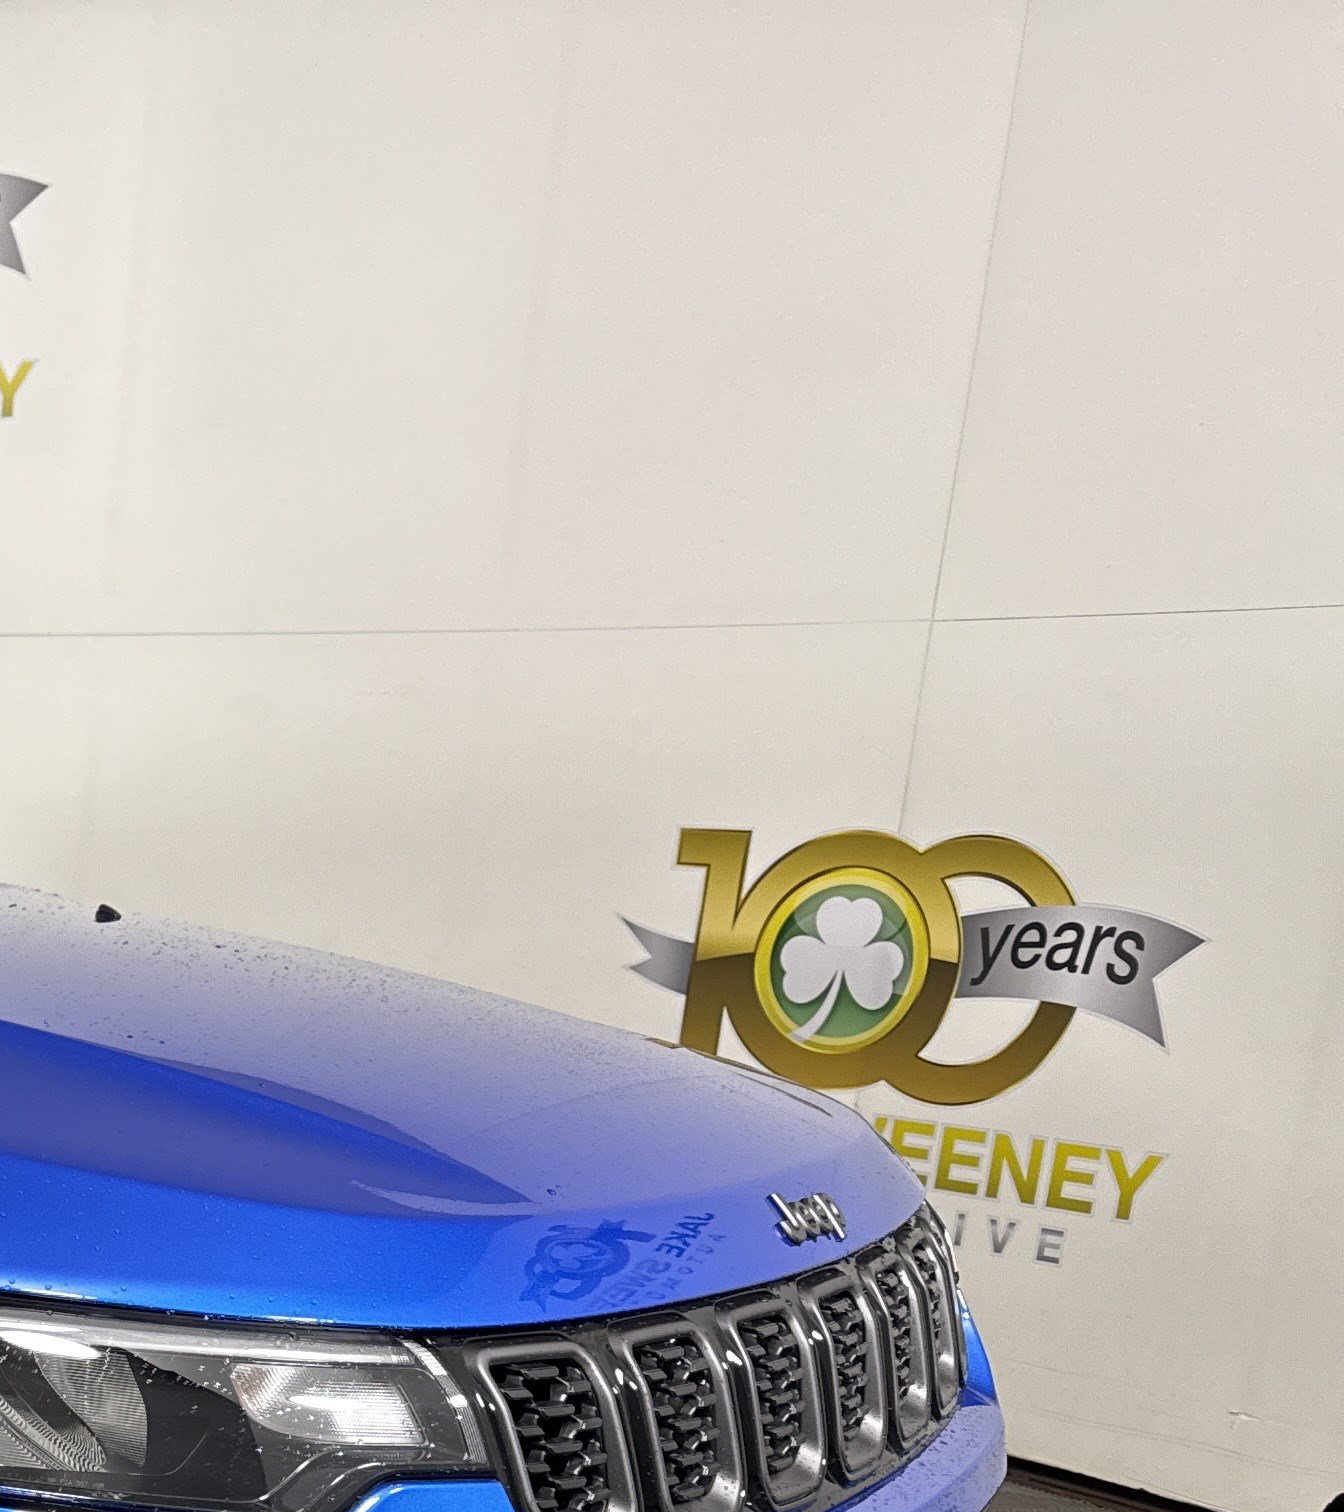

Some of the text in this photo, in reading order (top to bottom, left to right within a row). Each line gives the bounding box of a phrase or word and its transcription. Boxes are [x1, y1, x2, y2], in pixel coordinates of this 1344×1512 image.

[676, 828, 1078, 1105] 100
[970, 920, 1146, 987] years
[874, 1116, 1164, 1221] EENEY
[765, 1192, 848, 1247] Jeep
